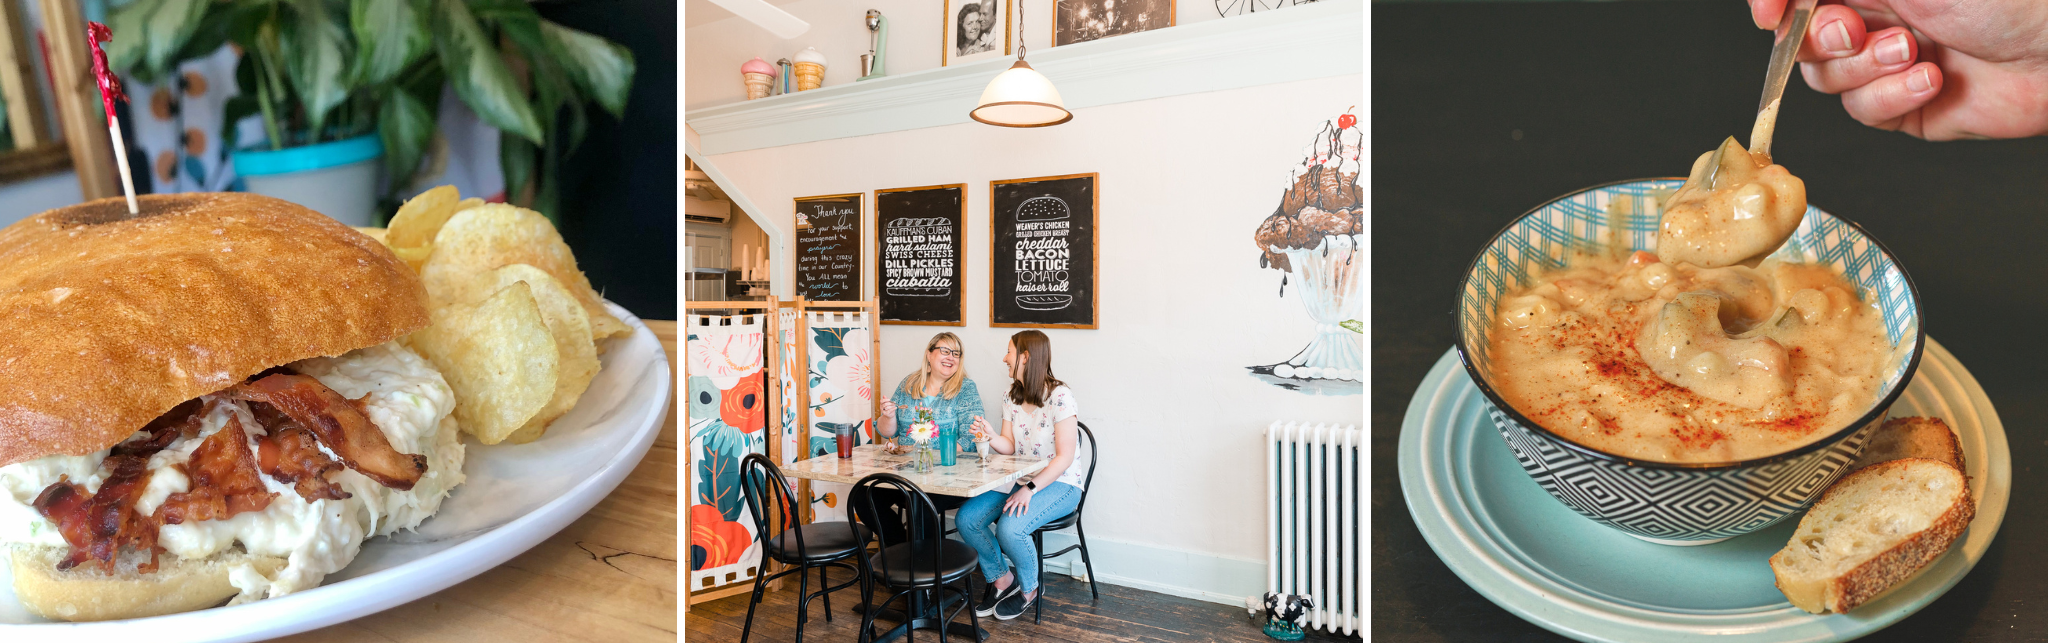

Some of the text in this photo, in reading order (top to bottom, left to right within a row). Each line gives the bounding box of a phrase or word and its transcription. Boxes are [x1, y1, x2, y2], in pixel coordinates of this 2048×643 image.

[811, 205, 855, 226] Thank you
[818, 226, 829, 236] your
[926, 225, 953, 235] CUBAN
[1015, 221, 1070, 231] WEAVER'S CHICKEN
[800, 234, 837, 246] encouragement
[886, 234, 952, 244] GRILLED HAM
[1015, 236, 1070, 250] cheddar
[885, 241, 953, 252] hard salami
[801, 256, 818, 265] during
[836, 254, 853, 262] crazy
[885, 249, 954, 259] SWISS CHEESE
[1015, 249, 1070, 260] BACON
[798, 263, 809, 271] time
[885, 258, 954, 268] DILL PICKLES
[1015, 259, 1070, 271] LETTUCE
[805, 273, 816, 281] You
[886, 267, 953, 278] SPICY BROWN MUSTARD
[1015, 270, 1069, 282] TOMATO
[842, 281, 849, 290] to
[886, 276, 953, 288] ciabatta
[1015, 280, 1070, 292] kaiser roll
